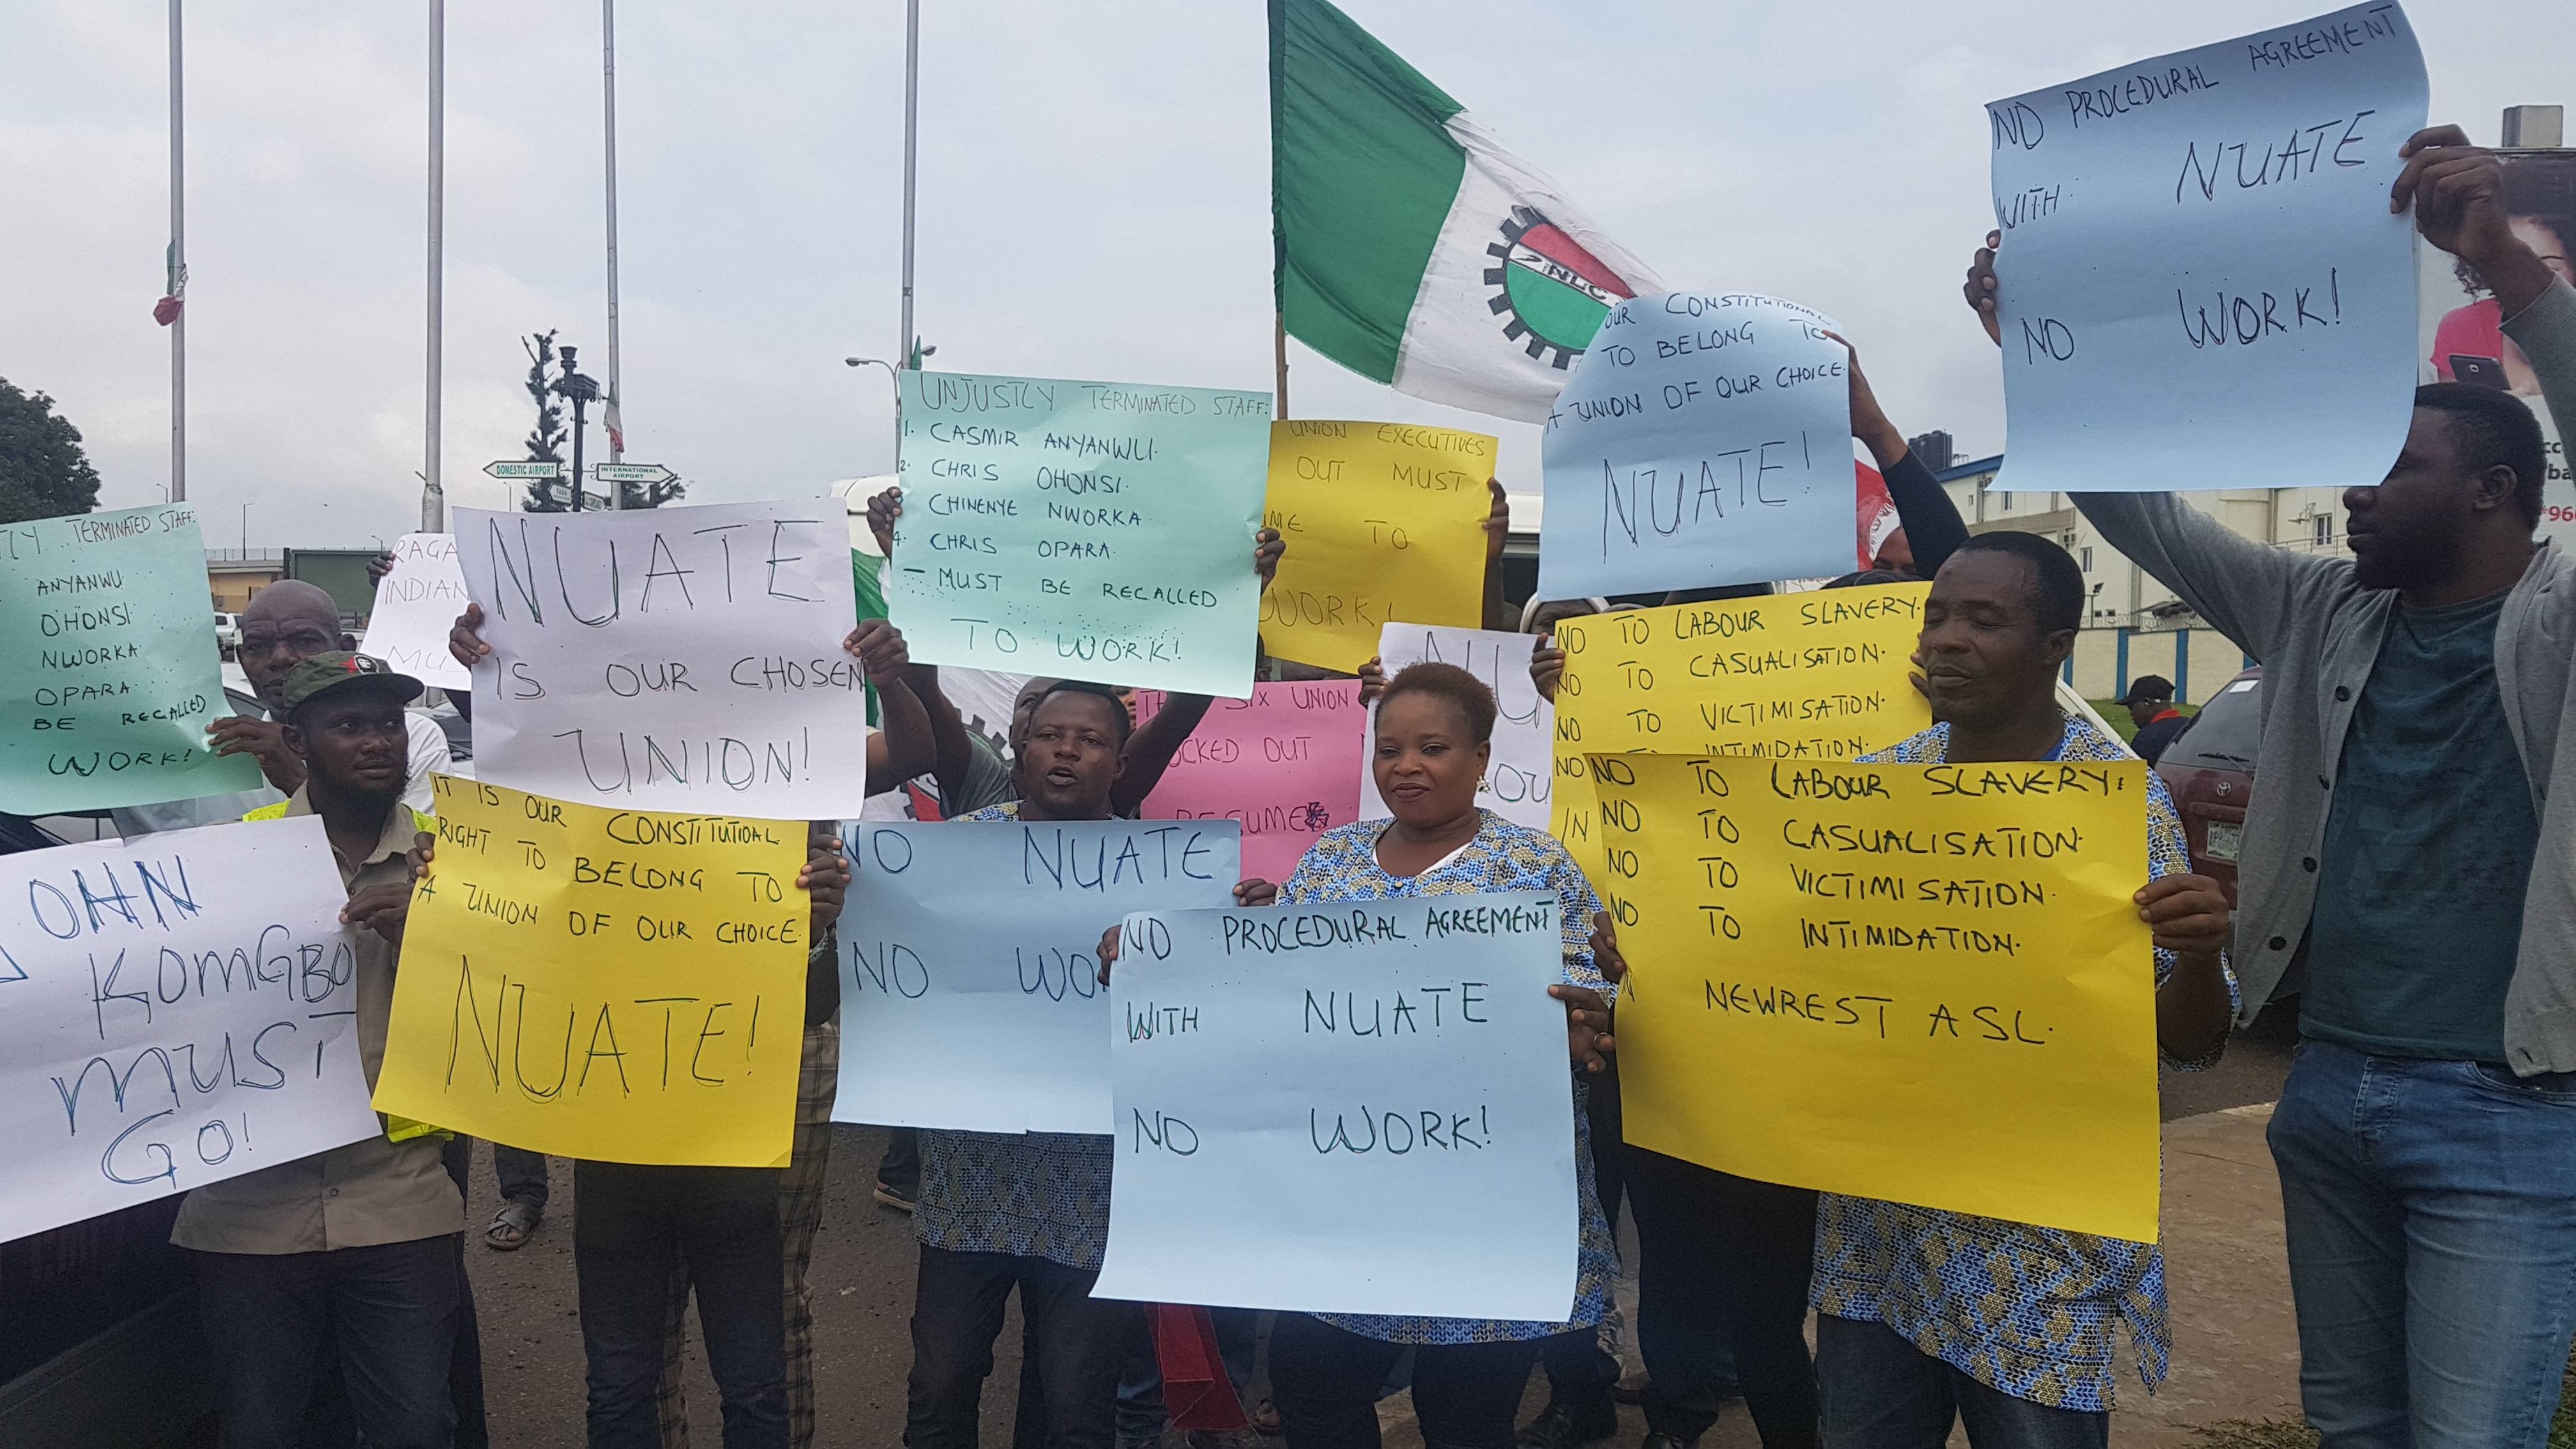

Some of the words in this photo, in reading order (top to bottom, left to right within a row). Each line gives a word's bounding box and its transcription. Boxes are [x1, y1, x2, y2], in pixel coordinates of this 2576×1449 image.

[1992, 102, 2044, 150] NO
[2065, 65, 2219, 128] PROCEDURAL
[2249, 4, 2396, 72] AGREEMENT
[2177, 110, 2375, 205] NUATE
[1548, 263, 1607, 300] NLC
[1605, 307, 1636, 329] OUR
[2020, 318, 2074, 365] NO
[2177, 267, 2340, 348] WORK!
[1601, 344, 1636, 367] TO
[1657, 321, 1754, 359] BELONG
[921, 373, 1054, 413] UNJUSTLY
[1082, 385, 1197, 415] TERMINATED
[1213, 395, 1269, 417] STAFF:
[1570, 393, 1643, 422] UNION
[1664, 381, 1701, 410] OF
[1717, 375, 1763, 399] OUR
[930, 422, 1019, 447] CASMIR
[1289, 422, 1347, 438] UNION
[1377, 424, 1484, 456] EXECUTIVES
[497, 464, 526, 475] DOMESTIC
[528, 465, 554, 475] AIRPORT
[931, 459, 999, 481] CHRIS
[1297, 456, 1345, 480] OUT
[1393, 463, 1468, 491] MUST
[929, 493, 1018, 516] CHINENYE
[1604, 431, 1811, 564] NUATE!
[66, 510, 151, 544] TERMINATED
[930, 533, 997, 555] CHRIS
[1365, 520, 1409, 549] TO
[490, 517, 825, 627] NUATE
[939, 567, 1002, 592] MUST
[1041, 578, 1071, 595] BE
[1103, 583, 1217, 608] RECALLED
[950, 618, 1018, 653] TO
[1057, 634, 1181, 663] WORK!
[1557, 625, 1586, 654] NO
[1613, 615, 1649, 645] TO
[1675, 609, 1764, 639] LABOUR
[497, 657, 546, 700] IS
[606, 658, 697, 697] OUR
[731, 656, 864, 693] CHOSEN
[1291, 686, 1349, 710] UNION
[1556, 671, 1581, 696] NO
[1617, 661, 1653, 691] TO
[33, 717, 76, 730] BE
[121, 694, 206, 725] RECALLED
[1557, 716, 1581, 742] NO
[1627, 709, 1661, 733] TO
[49, 749, 192, 777] WORK!
[554, 725, 809, 796] UNION!
[1264, 737, 1312, 763] OUT
[1556, 755, 1584, 778] NO
[1591, 756, 1635, 785] NO
[1687, 760, 1729, 797] TO
[1772, 761, 1890, 800] LABOUR
[478, 785, 499, 806] IS
[525, 795, 567, 827] OUR
[1602, 799, 1641, 832] NO
[1697, 809, 1740, 843] TO
[439, 816, 491, 855] RIGHT
[518, 841, 546, 870] TO
[574, 857, 703, 892] BELONG
[736, 871, 782, 903] TO
[840, 825, 912, 873] NO
[1024, 825, 1215, 893] NUATE
[1608, 848, 1639, 878] NO
[1698, 857, 1738, 889] TO
[29, 855, 203, 939] OHN
[416, 875, 436, 903] A
[464, 883, 538, 925] UNION
[569, 912, 611, 936] OF
[637, 915, 693, 942] OUR
[1610, 894, 1639, 926] NO
[1699, 905, 1742, 940] TO
[1122, 918, 1171, 960] NO
[1223, 910, 1406, 954] PROCEDURAL
[1425, 900, 1554, 940] AGREEMENT
[853, 942, 928, 998] NO
[1016, 947, 1107, 1002] WO
[444, 954, 760, 1103] NUATE!
[1127, 1001, 1199, 1043] WITH
[1305, 983, 1488, 1037] NUATE
[1705, 979, 1892, 1039] NEWREST
[102, 1109, 252, 1188] GO!
[1133, 1107, 1199, 1156] NO
[1311, 1105, 1492, 1154] WORK!
